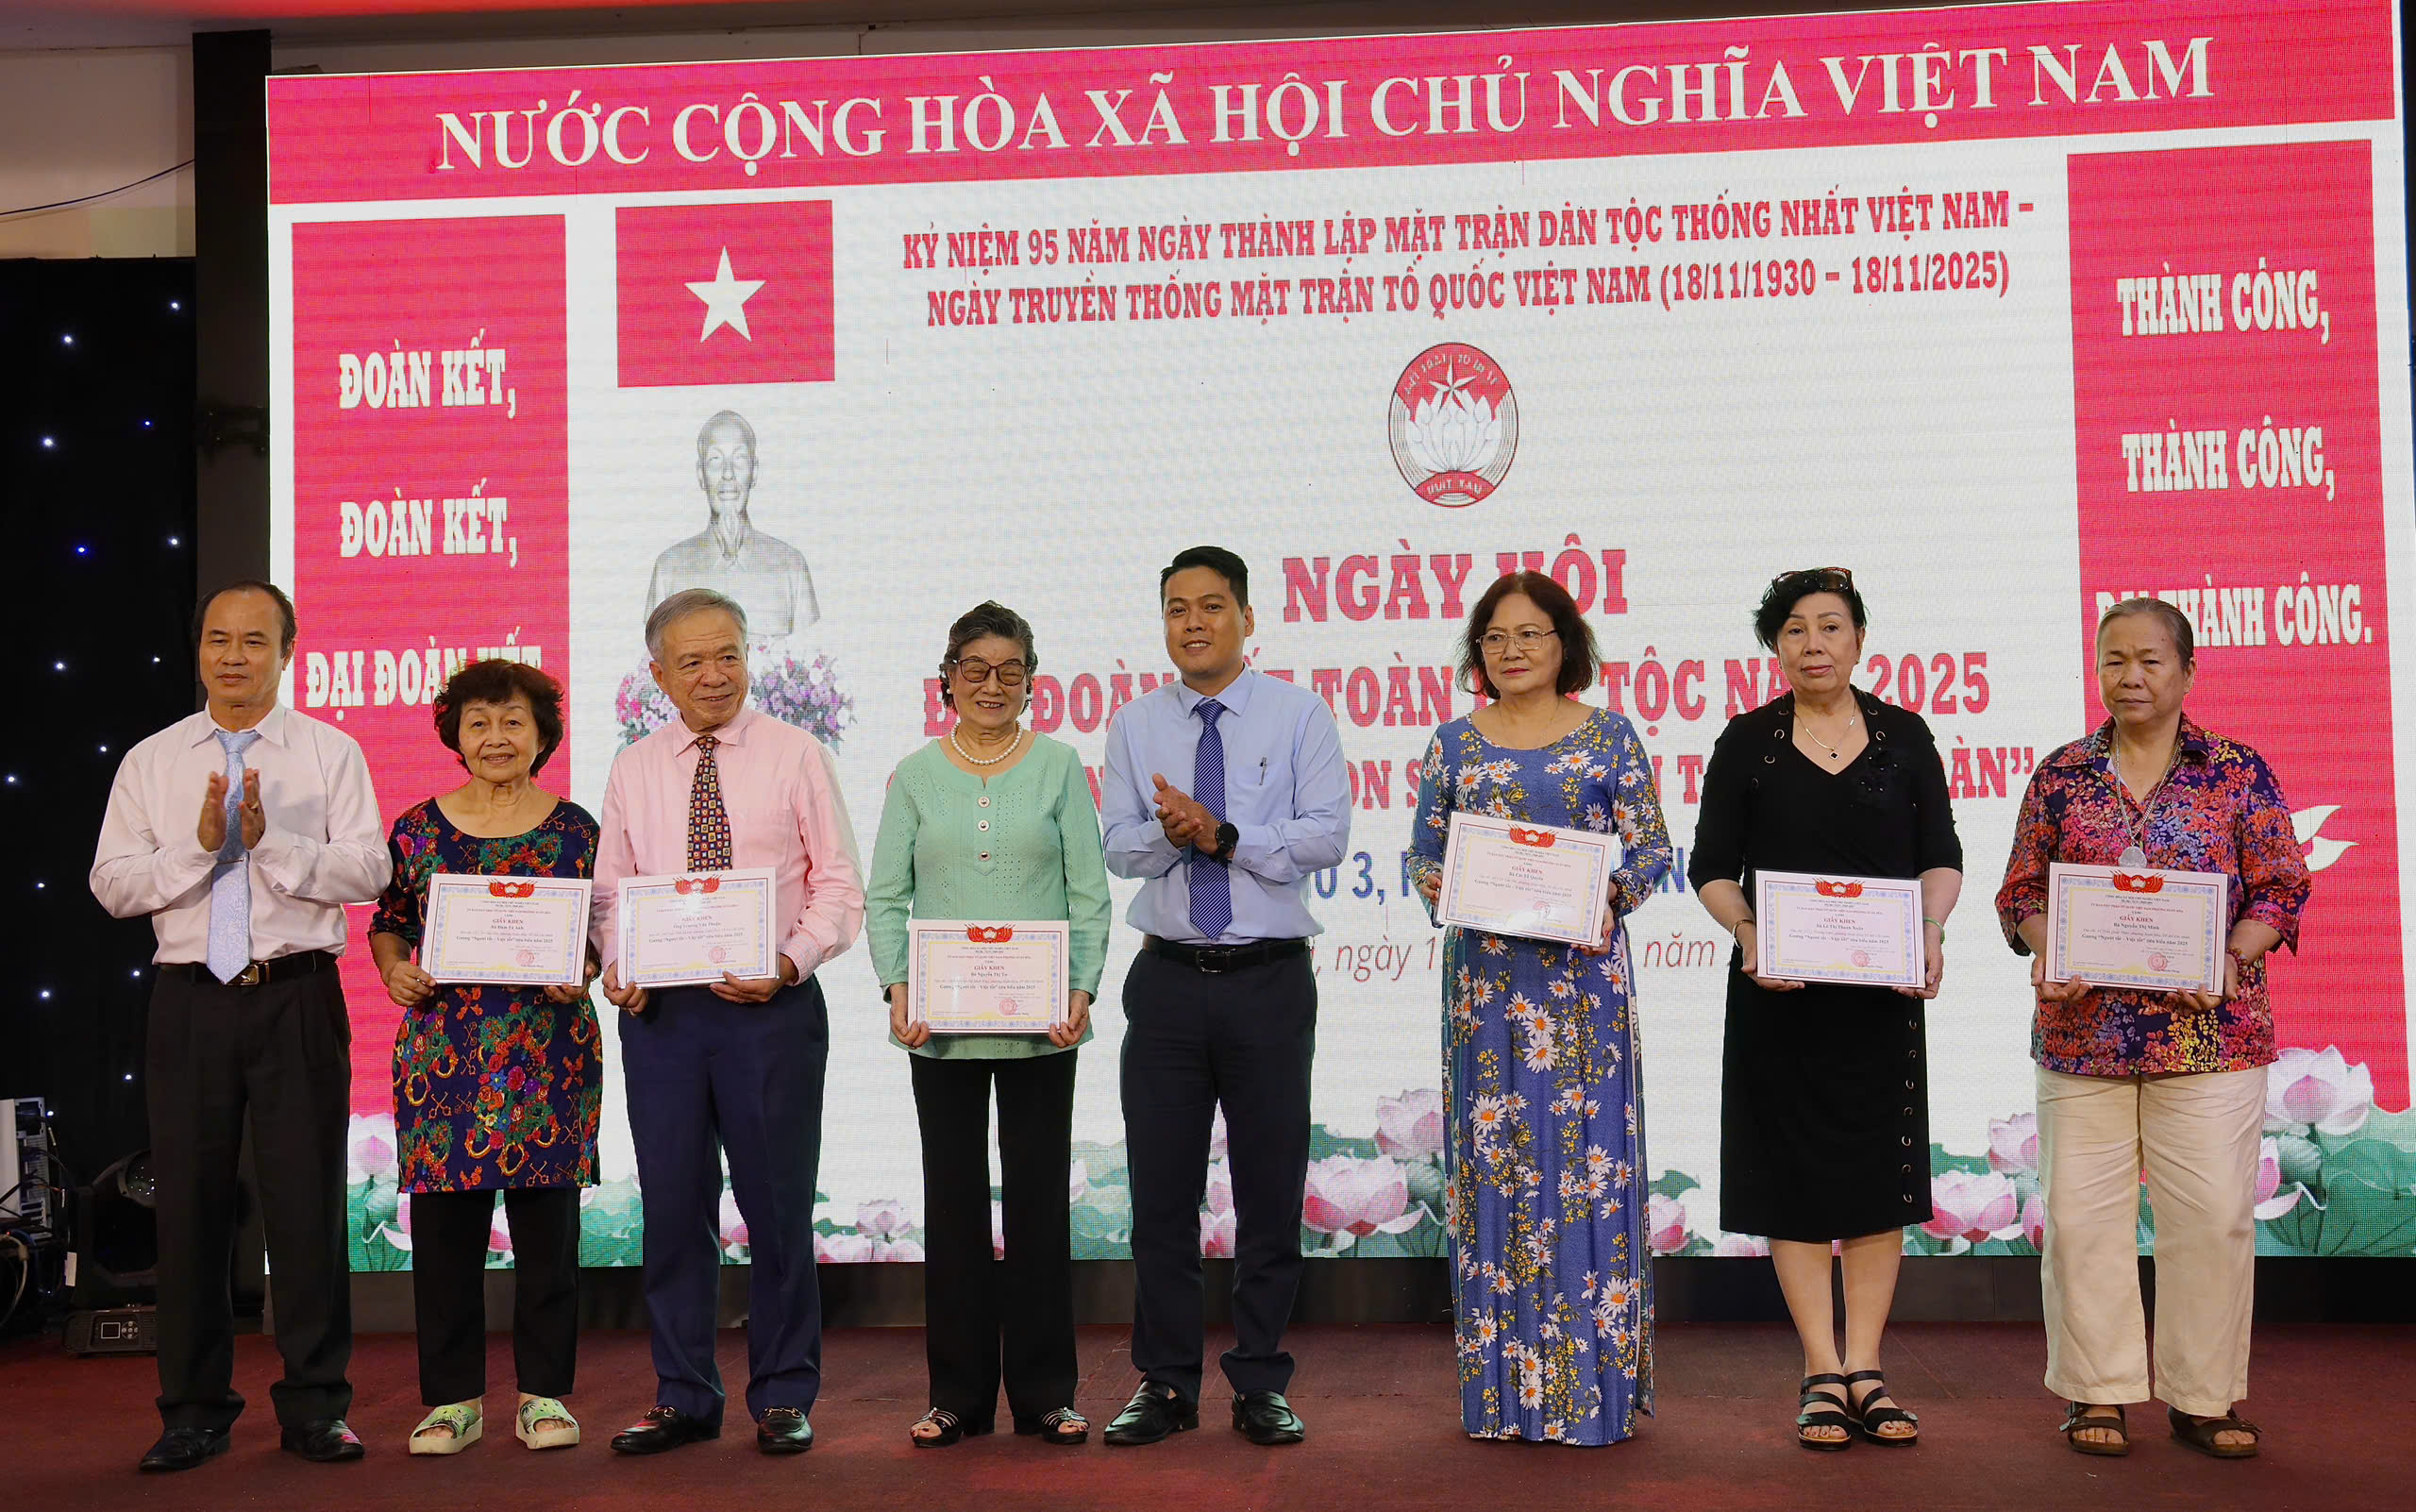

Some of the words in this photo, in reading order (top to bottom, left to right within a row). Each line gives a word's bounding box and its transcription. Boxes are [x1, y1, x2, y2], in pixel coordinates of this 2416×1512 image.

[437, 91, 649, 169] NƯỚC
[674, 92, 886, 176] CỘNG
[906, 76, 1069, 153] HÒA
[1085, 72, 1188, 146] XÃ
[1210, 73, 1348, 156] HỘI
[1371, 56, 1530, 136] CHỦ
[1553, 45, 1807, 127] NGHĨA
[1820, 42, 2006, 127] VIỆT
[2027, 38, 2213, 105] NAM
[904, 222, 939, 269] KỶ
[948, 225, 1019, 276] NIỆM
[1030, 230, 1059, 264] 95
[1068, 220, 1130, 264] NĂM
[1140, 215, 1212, 262] NGÀY
[1221, 214, 1316, 259] THÀNH
[1325, 211, 1377, 264] LẬP
[1385, 210, 1445, 261] MẶT
[1455, 206, 1529, 259] TRẬN
[1540, 202, 1598, 246] DÂN
[1607, 198, 1663, 252] TỘC
[1672, 189, 1771, 242] THỐNG
[1782, 184, 1858, 237] NHẤT
[1867, 187, 1933, 242] VIỆT
[1944, 191, 2009, 230] NAM
[929, 281, 1001, 328] NGÀY
[1010, 272, 1116, 324] TRUYỀN
[1127, 269, 1222, 320] THỐNG
[1232, 274, 1291, 324] MẶT
[1300, 270, 1374, 323] TRẬN
[1384, 260, 1419, 311] TỔ
[1431, 258, 1505, 319] QUỐC
[1515, 262, 1578, 316] VIỆT
[1587, 266, 1652, 304] NAM
[1661, 260, 1816, 311] (18/11/1930
[1854, 252, 2009, 297] 18/11/2025)
[2118, 262, 2223, 335] THÀNH
[2232, 257, 2328, 344] CÔNG,
[340, 340, 431, 409] ĐOÀN
[442, 328, 515, 418] KẾT,
[2122, 419, 2228, 492] THÀNH
[2238, 415, 2334, 500] CÔNG,
[341, 488, 432, 557] ĐOÀN
[444, 479, 517, 567] KẾT,
[1284, 539, 1472, 623] NGÀY
[2158, 573, 2267, 647] HÀNH
[2275, 572, 2372, 646] CÔNG.
[307, 651, 364, 720] ĐẠI
[1032, 661, 1174, 734] ĐOÀ
[1314, 655, 1453, 728] TOÀN
[1601, 647, 1705, 737] TỘC
[1868, 653, 1989, 714] 2025
[1352, 851, 1384, 905] 3,
[1335, 934, 1412, 982] ngày
[1644, 931, 1716, 967] năm
